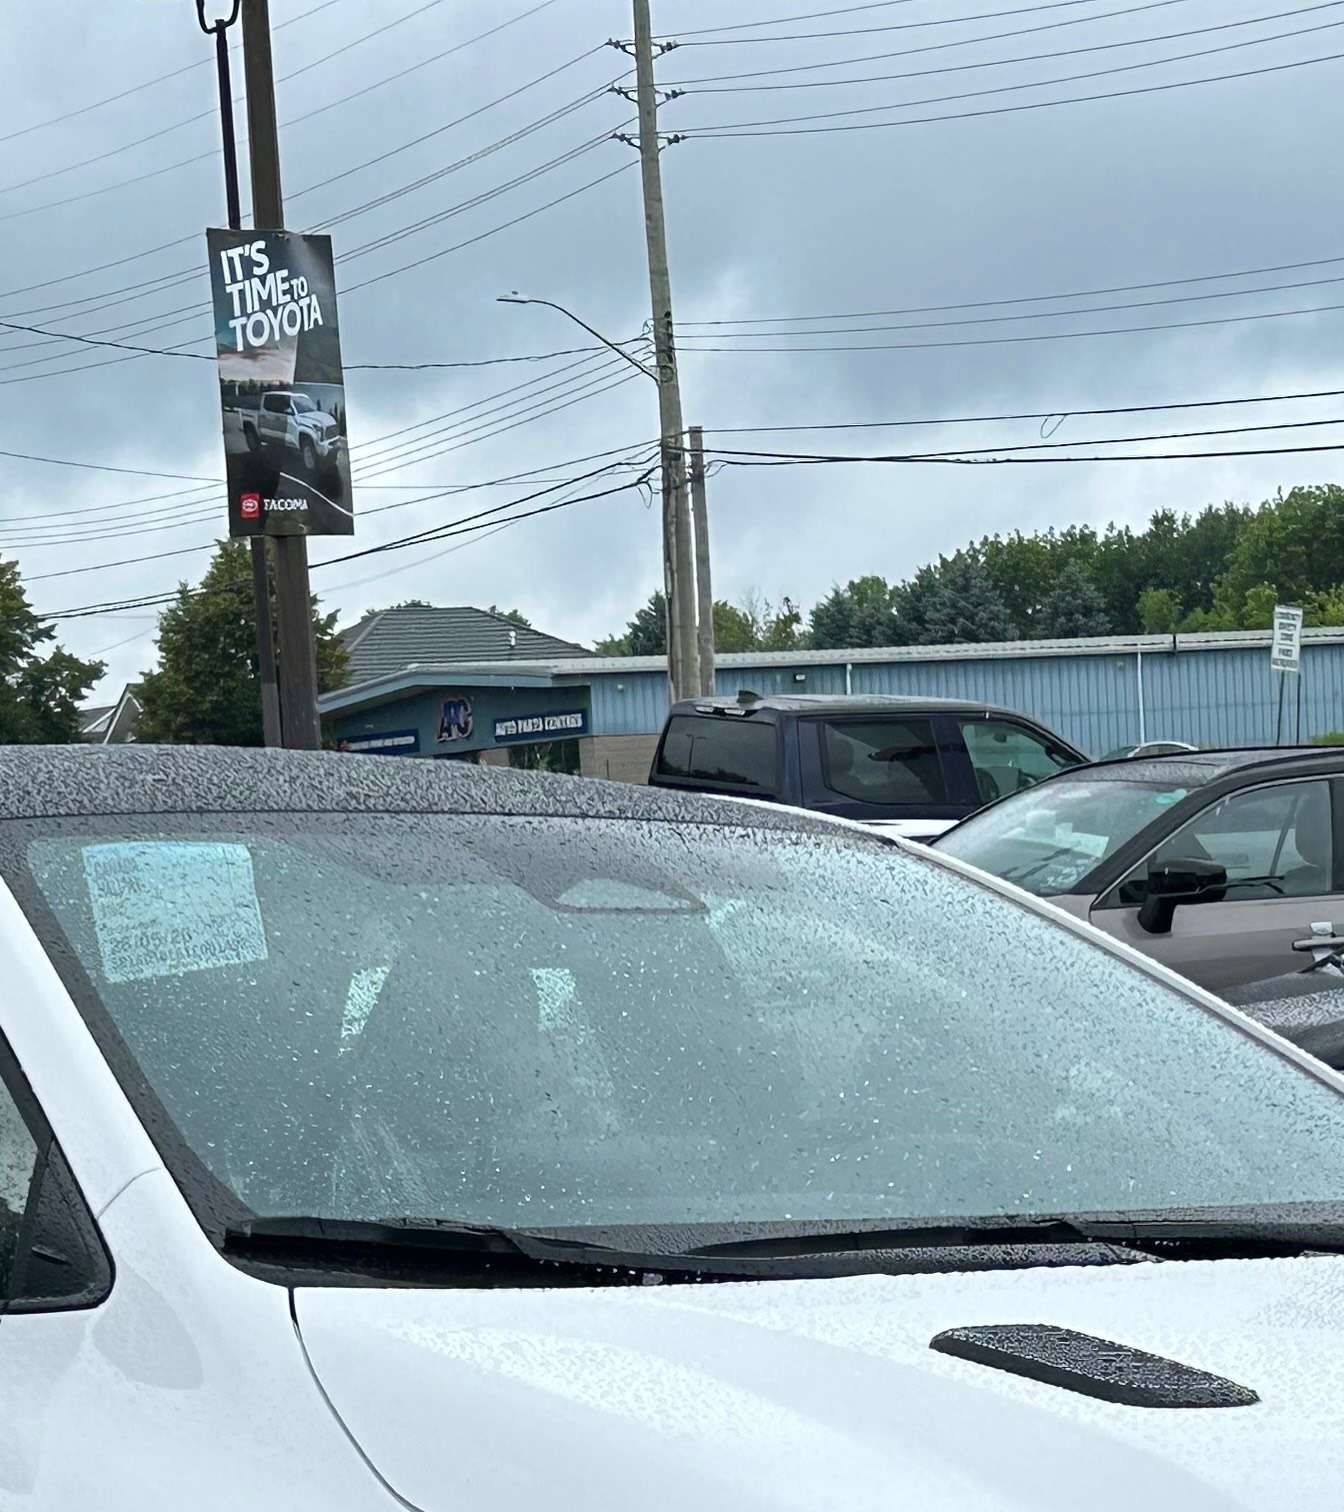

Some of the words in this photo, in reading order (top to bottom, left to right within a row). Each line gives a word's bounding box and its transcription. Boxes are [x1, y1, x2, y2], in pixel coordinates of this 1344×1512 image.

[220, 240, 270, 284] IT'S
[225, 269, 291, 317] TIME
[290, 276, 309, 300] TO
[229, 294, 323, 352] TOYOTA
[263, 499, 308, 512] TACOMA
